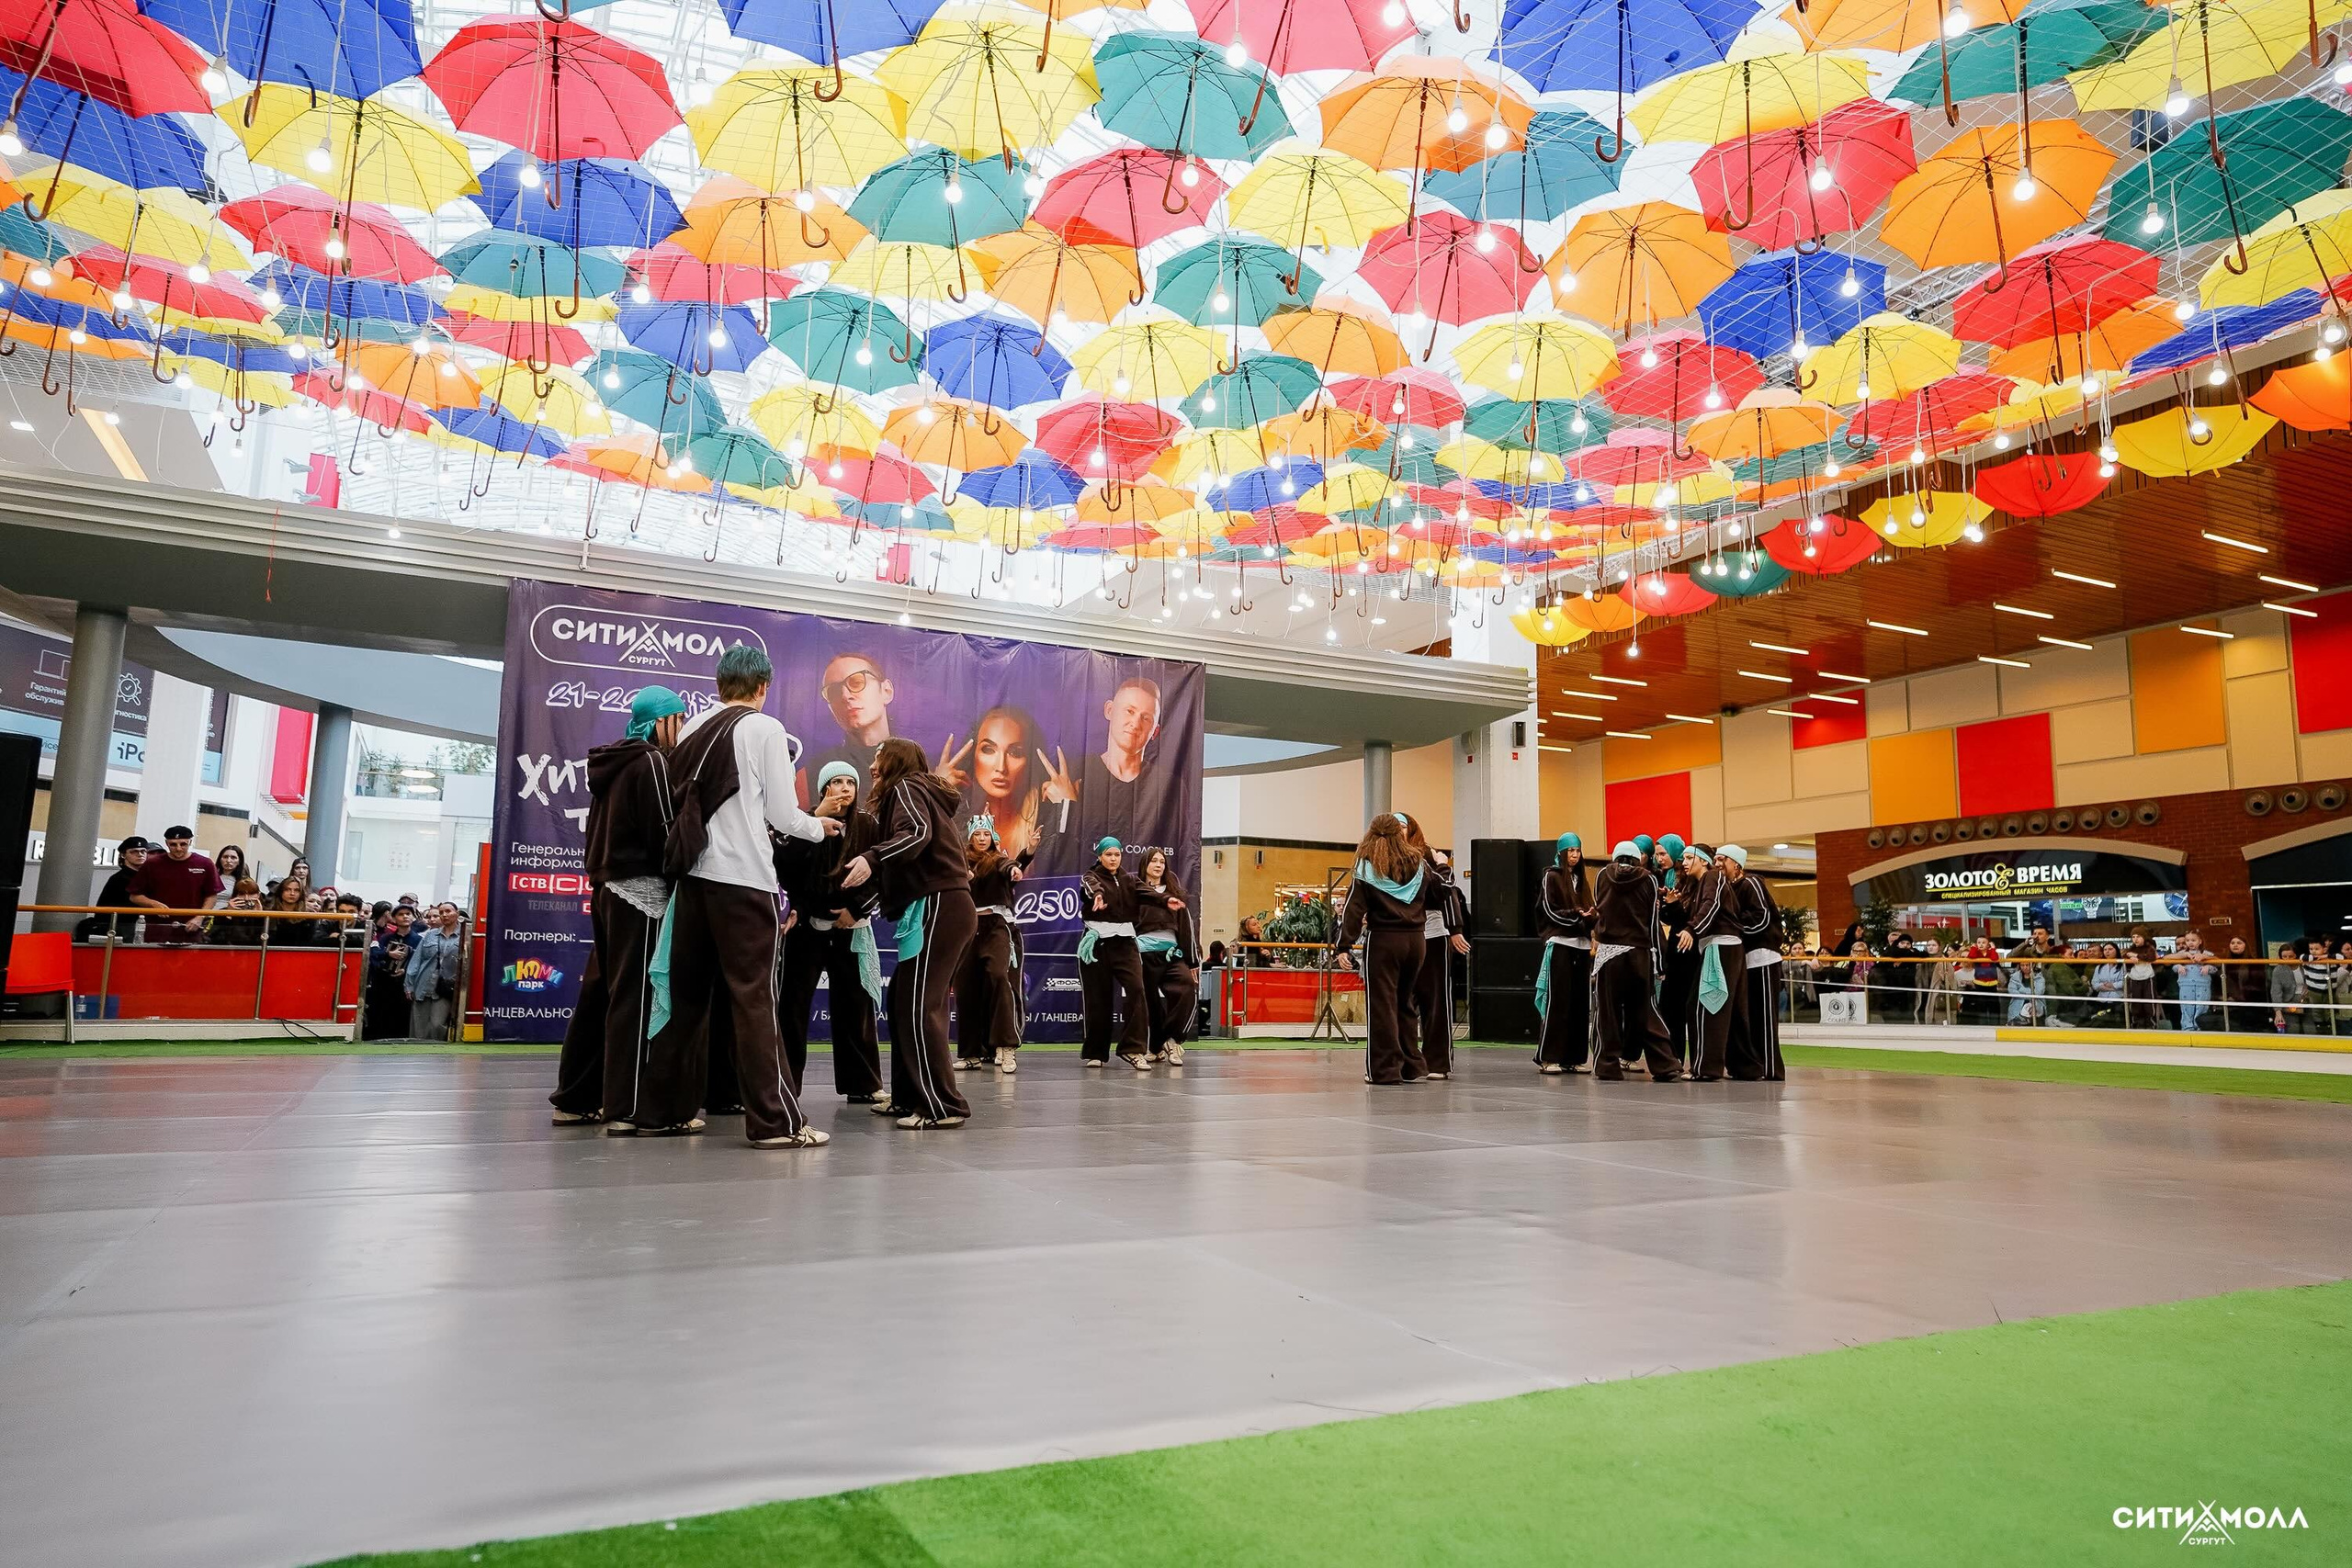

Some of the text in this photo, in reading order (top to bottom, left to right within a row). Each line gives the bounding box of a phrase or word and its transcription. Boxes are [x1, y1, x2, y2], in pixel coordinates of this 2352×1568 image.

[552, 618, 743, 657] СИТИ МОЛ
[628, 655, 667, 667] СУРГУТ
[30, 682, 67, 696] Гарантий
[25, 692, 65, 706] обслужив
[114, 709, 147, 722] гностика
[512, 841, 585, 857] Генеральн
[1125, 844, 1174, 855] СОЛЕВ
[510, 855, 585, 869] информа
[1925, 869, 1996, 889] ЗОЛОТО
[2017, 863, 2082, 884] ВРЕМЯ
[1940, 886, 2068, 899] СПЕЦИАЛИЗИРОВАННЫЙ МАГАЗИН ЧАСОВ
[527, 899, 578, 912] ТЕЛЕКАНАЛ
[504, 929, 576, 943] Партнеры:
[517, 979, 545, 990] парк
[483, 1007, 576, 1020] АНЦЕВАЛЬНО
[1042, 1012, 1084, 1022] ТАНЦЕВА
